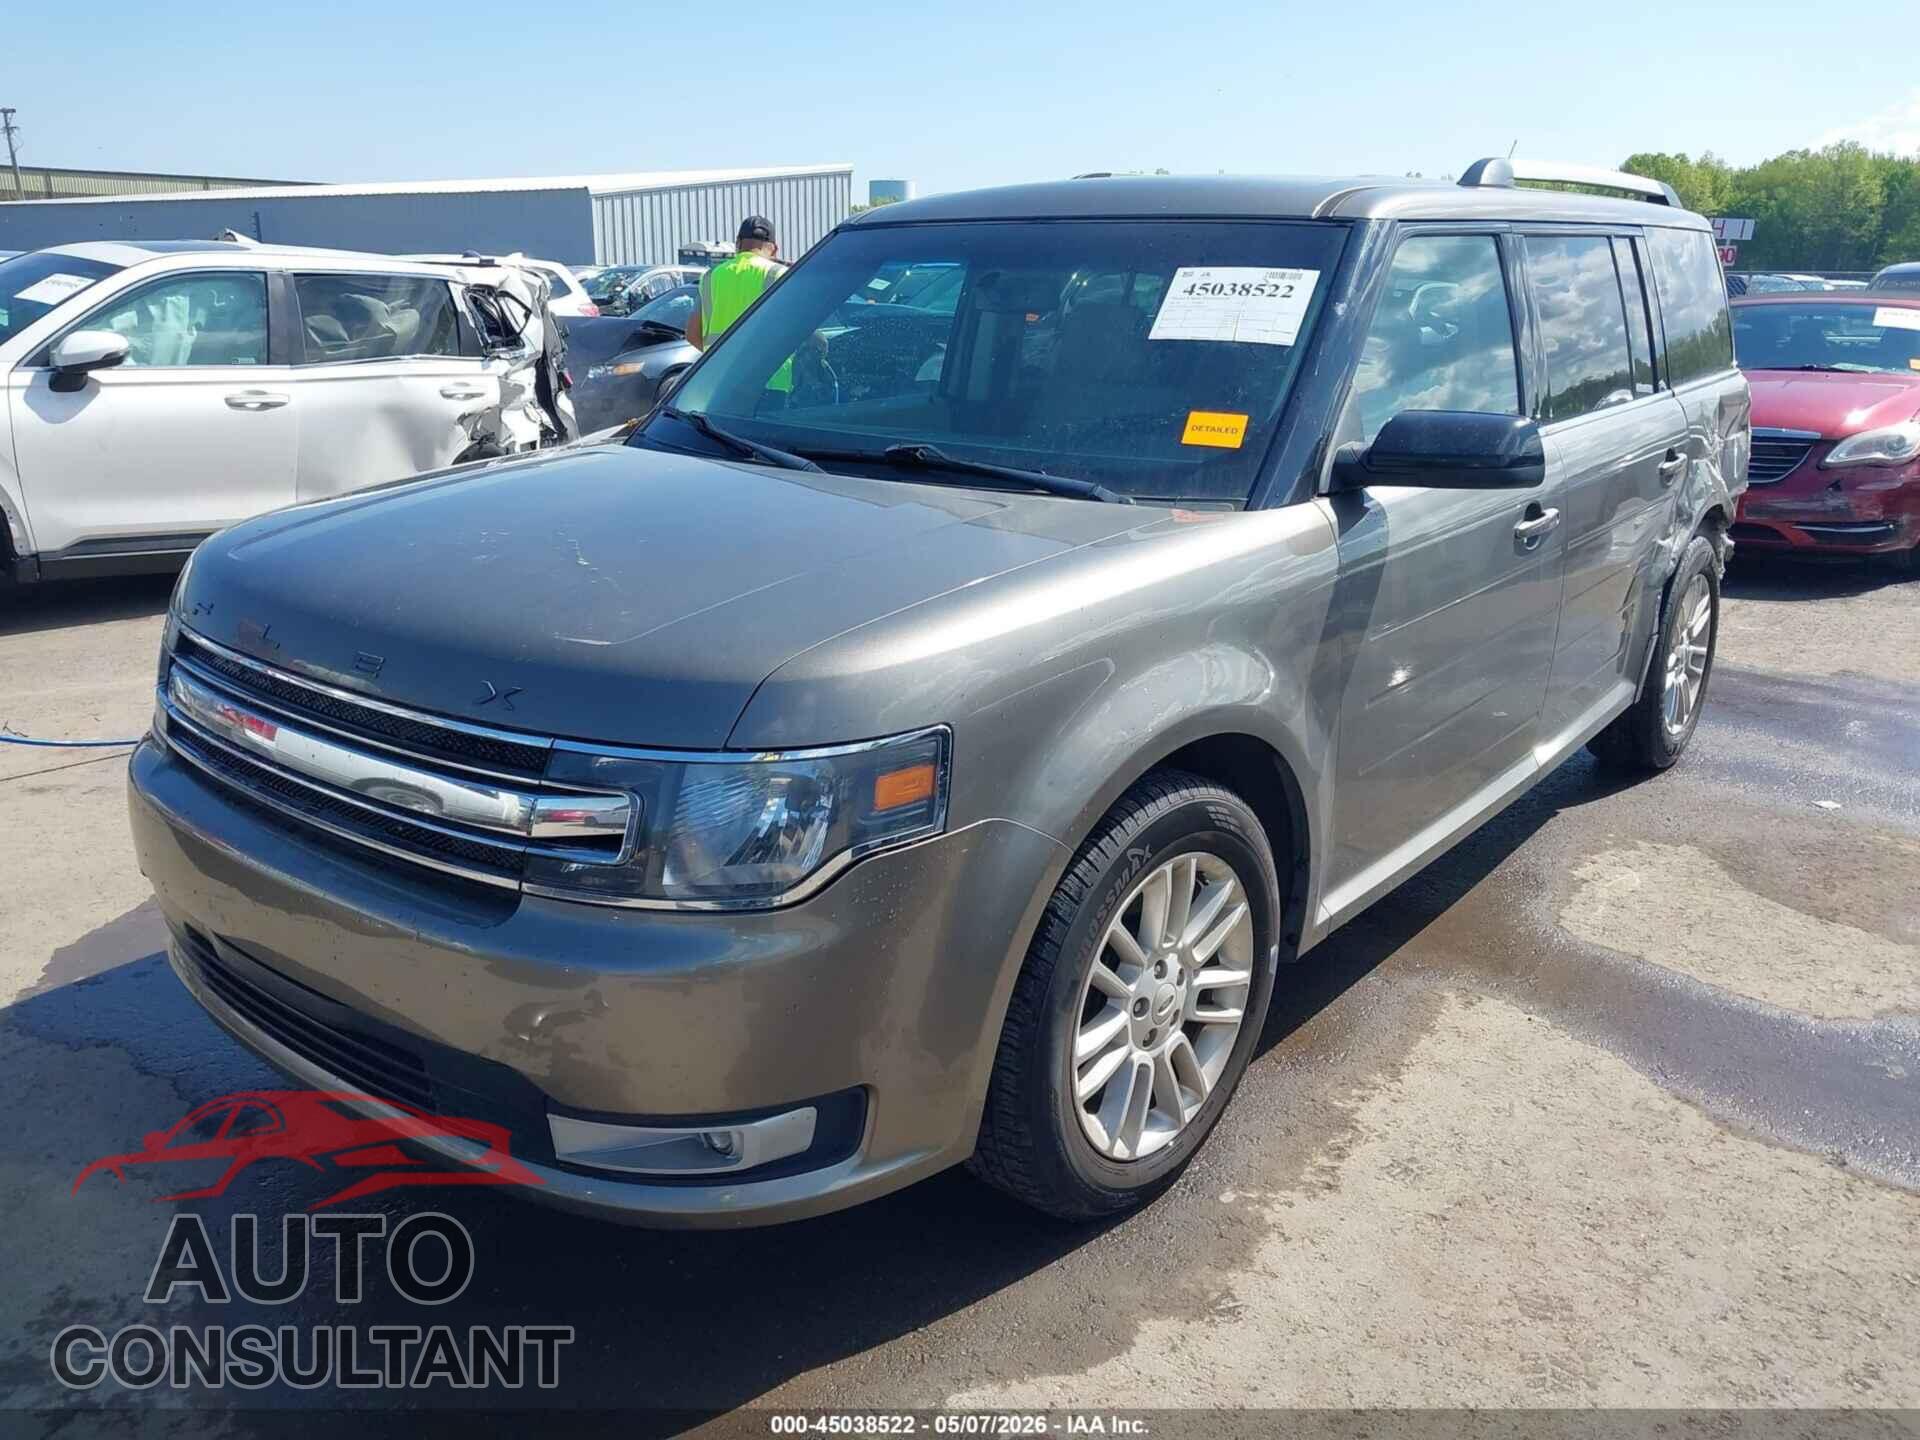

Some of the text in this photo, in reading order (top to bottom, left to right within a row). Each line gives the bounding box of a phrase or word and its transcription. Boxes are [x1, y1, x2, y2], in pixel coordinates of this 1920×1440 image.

[1183, 282, 1295, 298] 45038522
[1190, 423, 1239, 435] DETAILED
[1073, 843, 1153, 974] ROSSMAX
